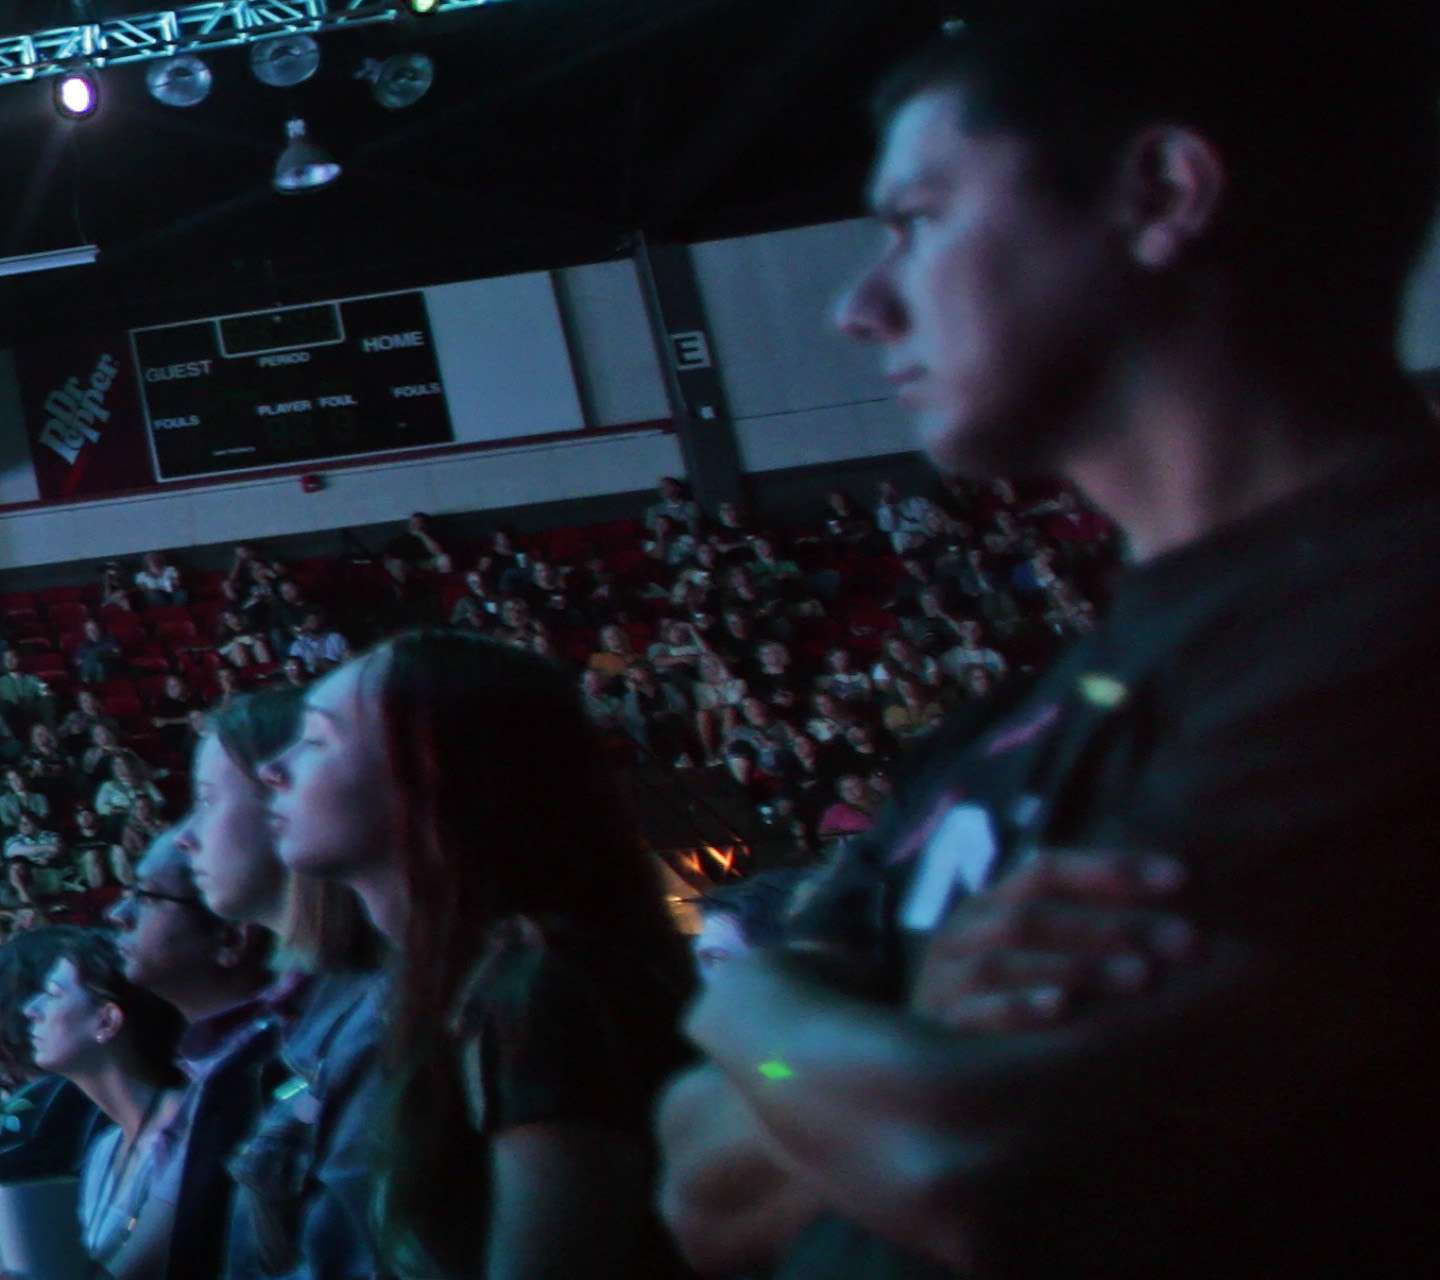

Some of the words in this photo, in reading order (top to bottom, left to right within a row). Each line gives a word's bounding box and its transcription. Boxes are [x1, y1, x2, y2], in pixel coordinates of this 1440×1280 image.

[361, 331, 425, 353] HOME
[674, 337, 703, 365] E
[145, 359, 213, 383] GUEST
[391, 381, 441, 398] FOULS
[256, 399, 312, 416] PLAYER
[318, 394, 358, 408] FOUL
[153, 414, 200, 431] FOULS
